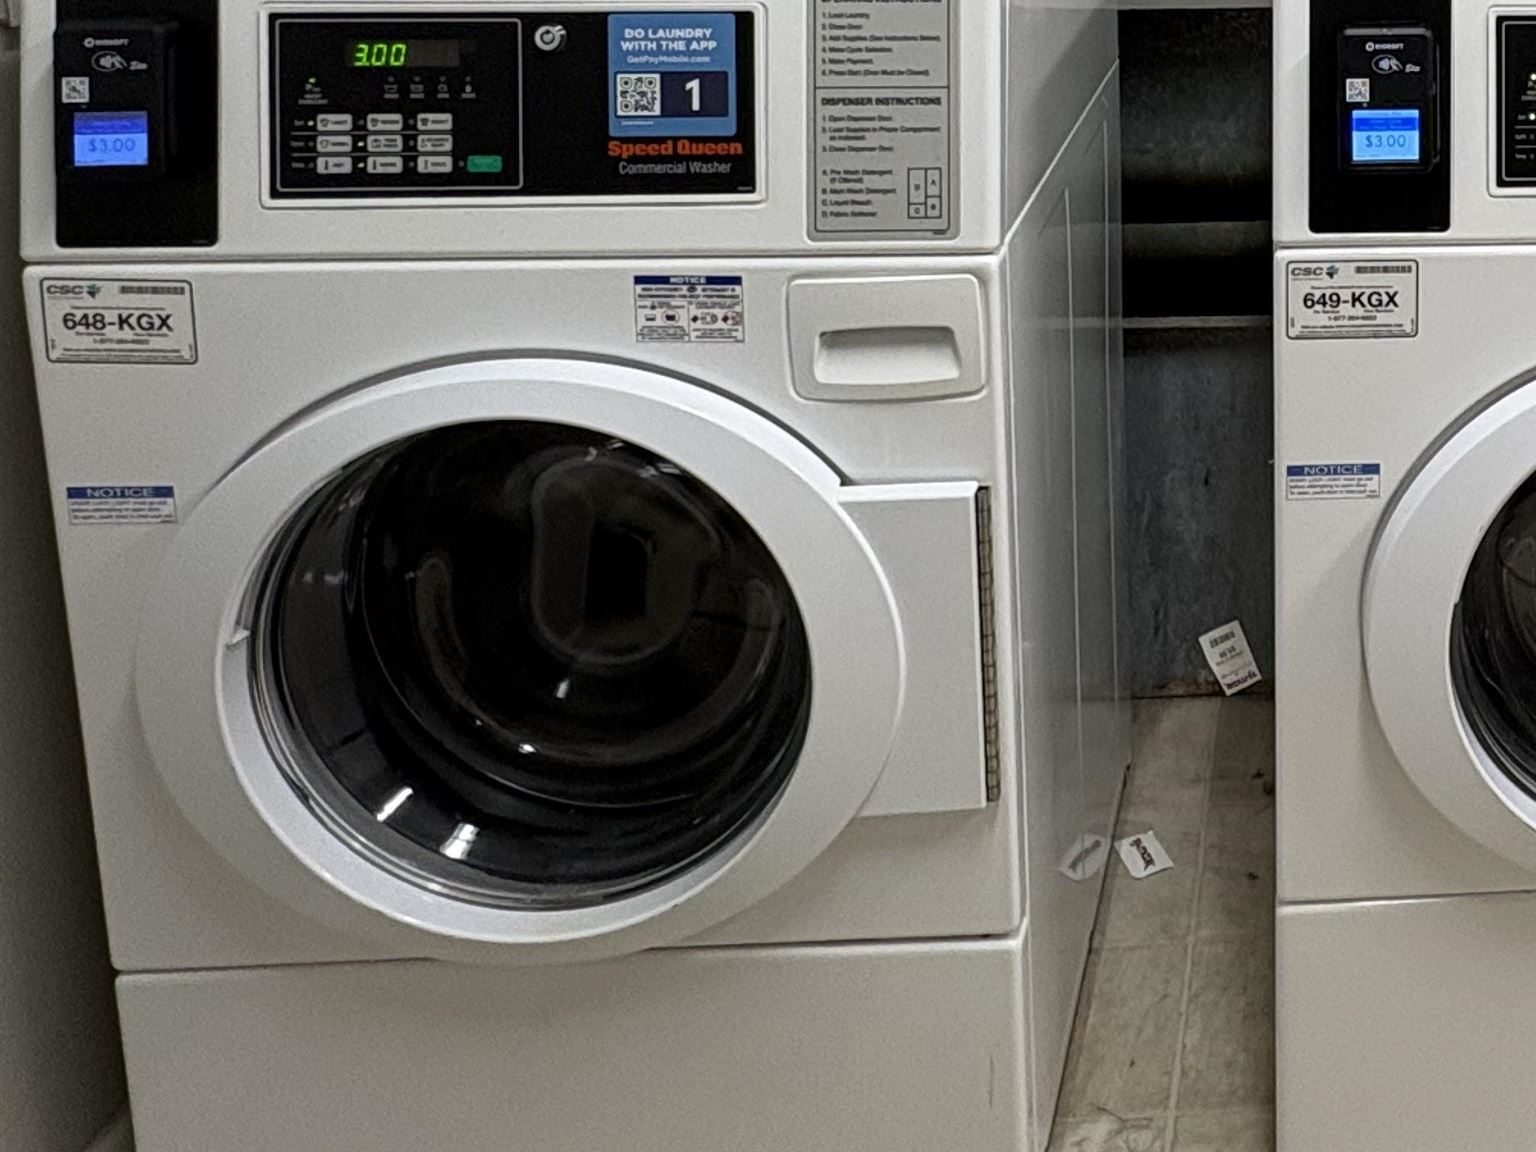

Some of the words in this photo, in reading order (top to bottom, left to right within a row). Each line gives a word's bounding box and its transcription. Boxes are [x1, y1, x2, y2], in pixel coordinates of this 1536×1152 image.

[624, 28, 645, 39] DO
[648, 28, 713, 39] LAUNDRY
[621, 40, 656, 51] WITH
[660, 40, 690, 51] THE
[692, 40, 718, 51] APP
[627, 55, 711, 65] GetPayMobile.com
[685, 77, 701, 112] 1
[821, 97, 873, 106] DISPENSER
[875, 97, 942, 106] INSTRUCTIONS
[607, 140, 673, 158] Speed
[677, 139, 743, 155] Queen
[619, 161, 687, 175] Commercial
[689, 161, 732, 174] Washer
[1291, 267, 1324, 276] CSC
[669, 276, 707, 284] NOTICE
[46, 285, 84, 296] CSC
[1303, 290, 1399, 309] 649-KGX
[62, 312, 173, 332] 648-KGX
[1304, 465, 1363, 475] NOTICE
[87, 488, 154, 498] NOTICE
